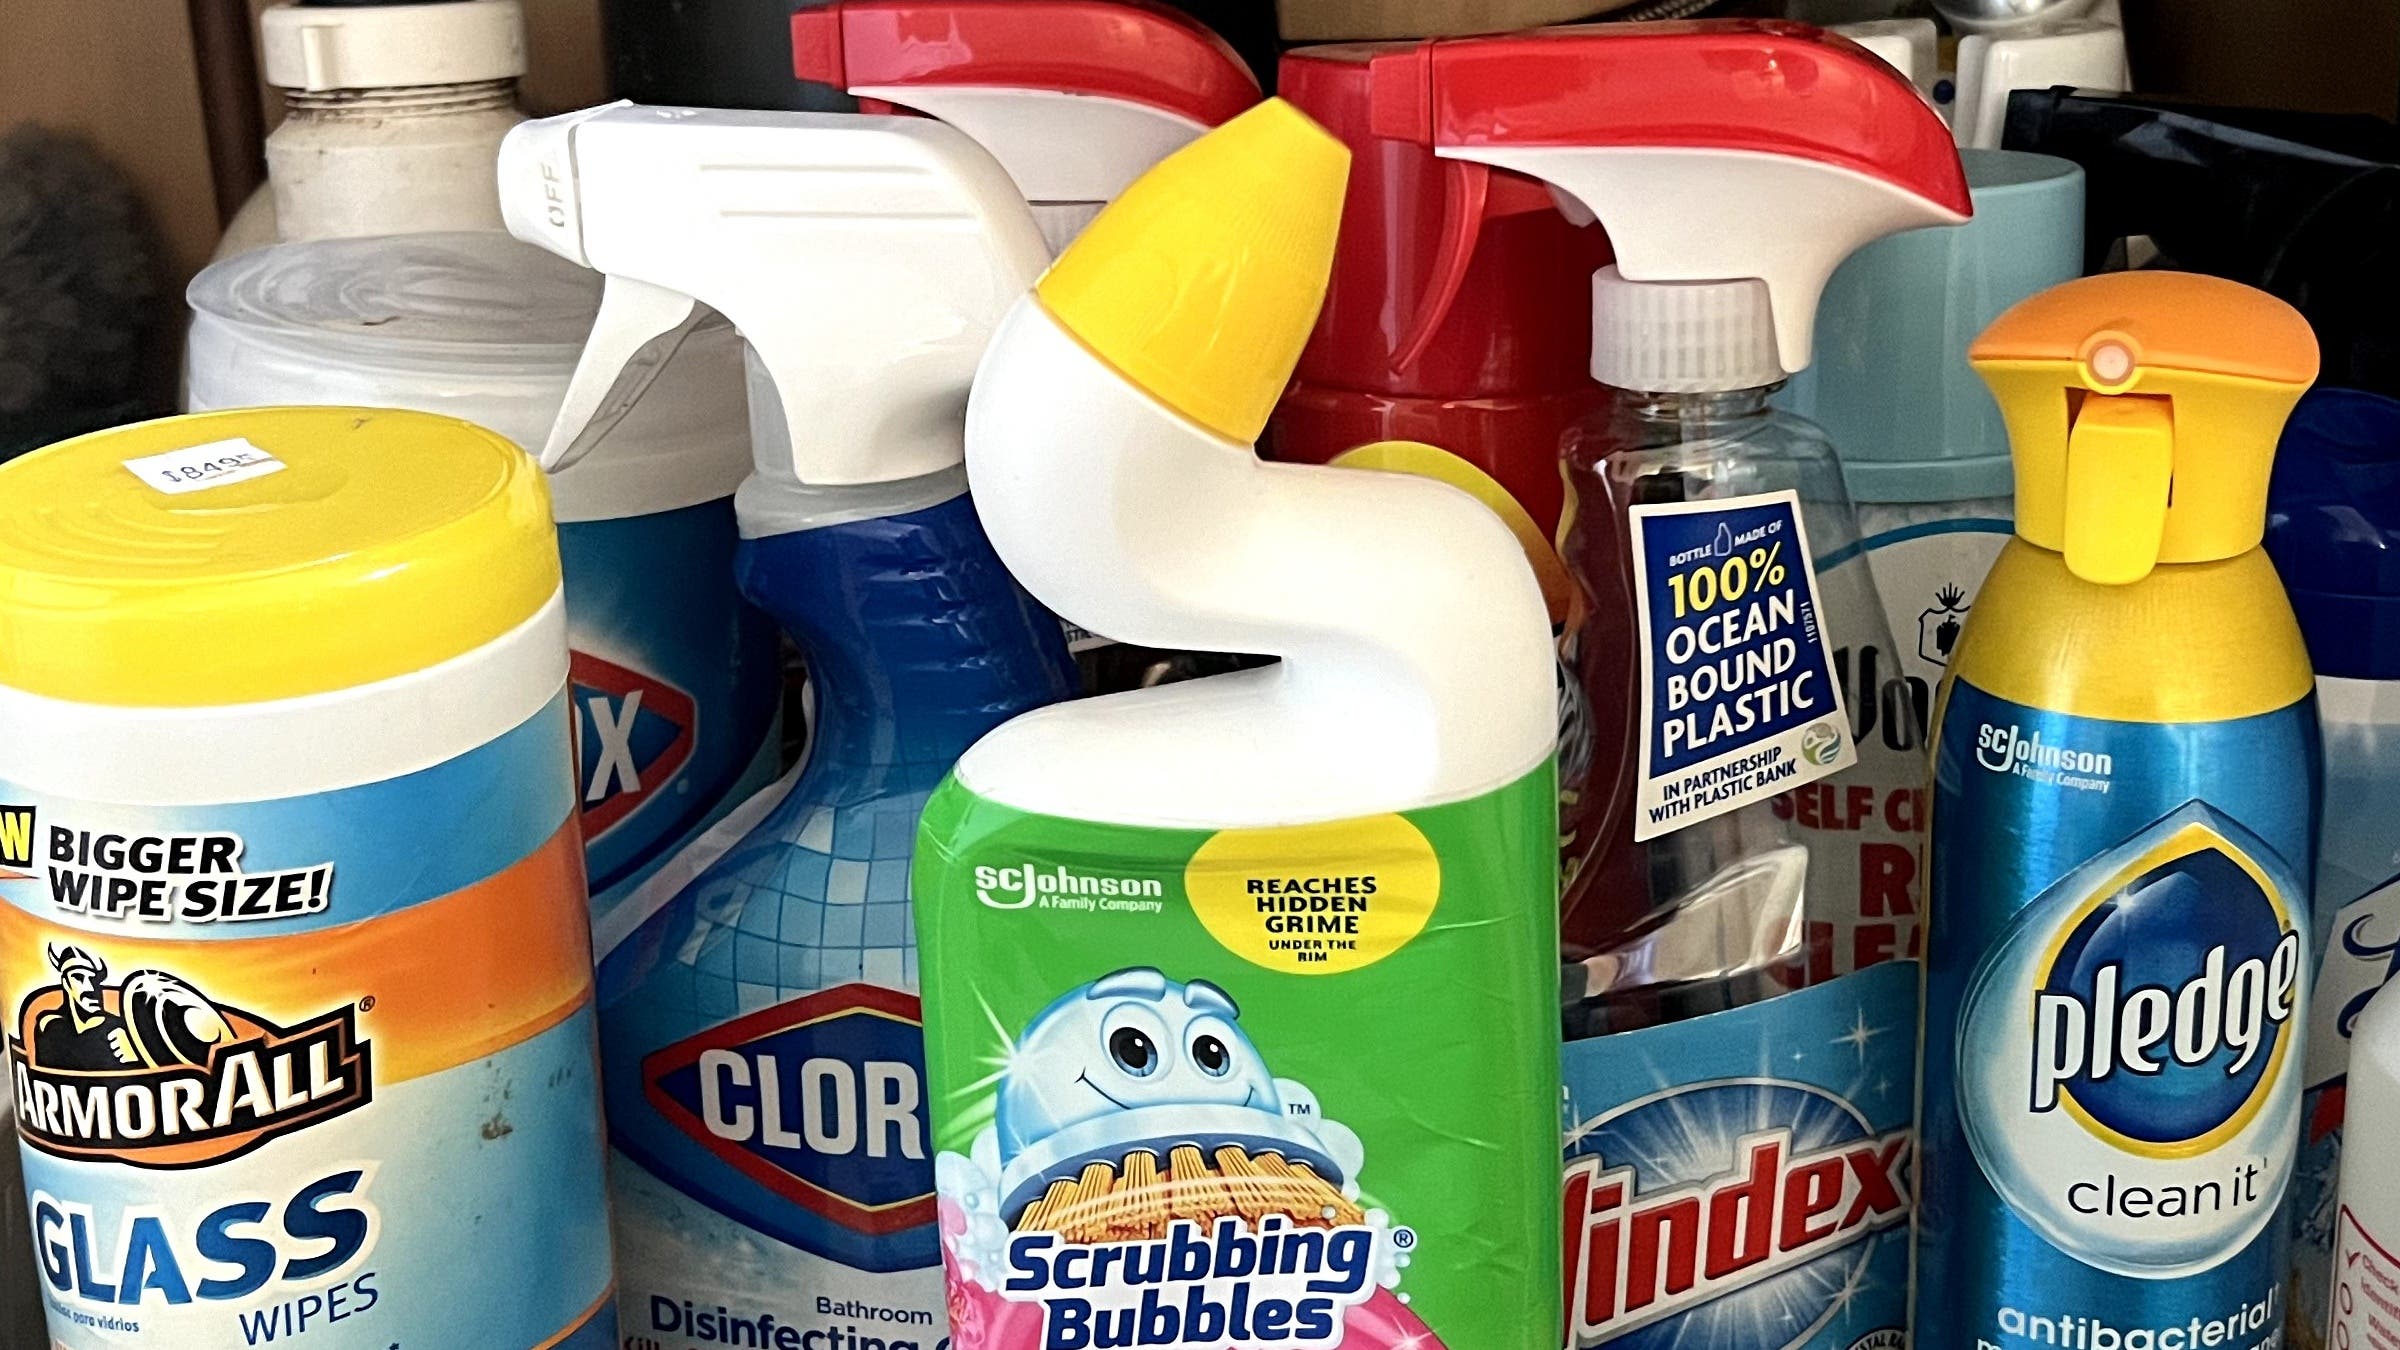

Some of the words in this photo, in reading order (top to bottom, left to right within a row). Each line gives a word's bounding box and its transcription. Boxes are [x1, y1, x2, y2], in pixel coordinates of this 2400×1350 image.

[540, 160, 565, 228] OFF
[1669, 544, 1712, 566] BOTTLE
[1734, 526, 1766, 546] MADE
[1768, 520, 1782, 534] OF
[1667, 541, 1785, 618] 100%
[1666, 589, 1794, 664] OCEAN
[1668, 637, 1796, 711] BOUND
[1663, 671, 1814, 758] PLASTIC
[1649, 798, 1690, 824] WITH
[1694, 775, 1753, 809] PLASTIC
[1757, 758, 1797, 787] BANK
[1663, 781, 1680, 800] IN
[1684, 746, 1782, 794] PARTNERSHIP
[50, 826, 236, 875] BIGGER
[48, 866, 169, 916] WIPE
[181, 868, 326, 918] SIZE!
[1039, 895, 1049, 908] A
[1052, 895, 1096, 912] Family
[1099, 898, 1162, 913] Company
[1247, 876, 1377, 894] REACHES
[1257, 896, 1367, 912] HIDDEN
[1265, 916, 1359, 934] GRIME
[1269, 939, 1322, 950] UNDER
[1327, 939, 1356, 950] THE
[1297, 952, 1327, 962] RIM
[2032, 932, 2299, 1111] pledge
[2068, 1174, 2221, 1218] clean
[36, 1170, 368, 1305] GLASS
[1006, 1218, 1373, 1293] Scrubbing
[98, 1315, 140, 1332] vidrios
[239, 1273, 379, 1346] WIPES
[815, 1296, 933, 1326] Bathroom
[1045, 1282, 1334, 1350] Bubbles
